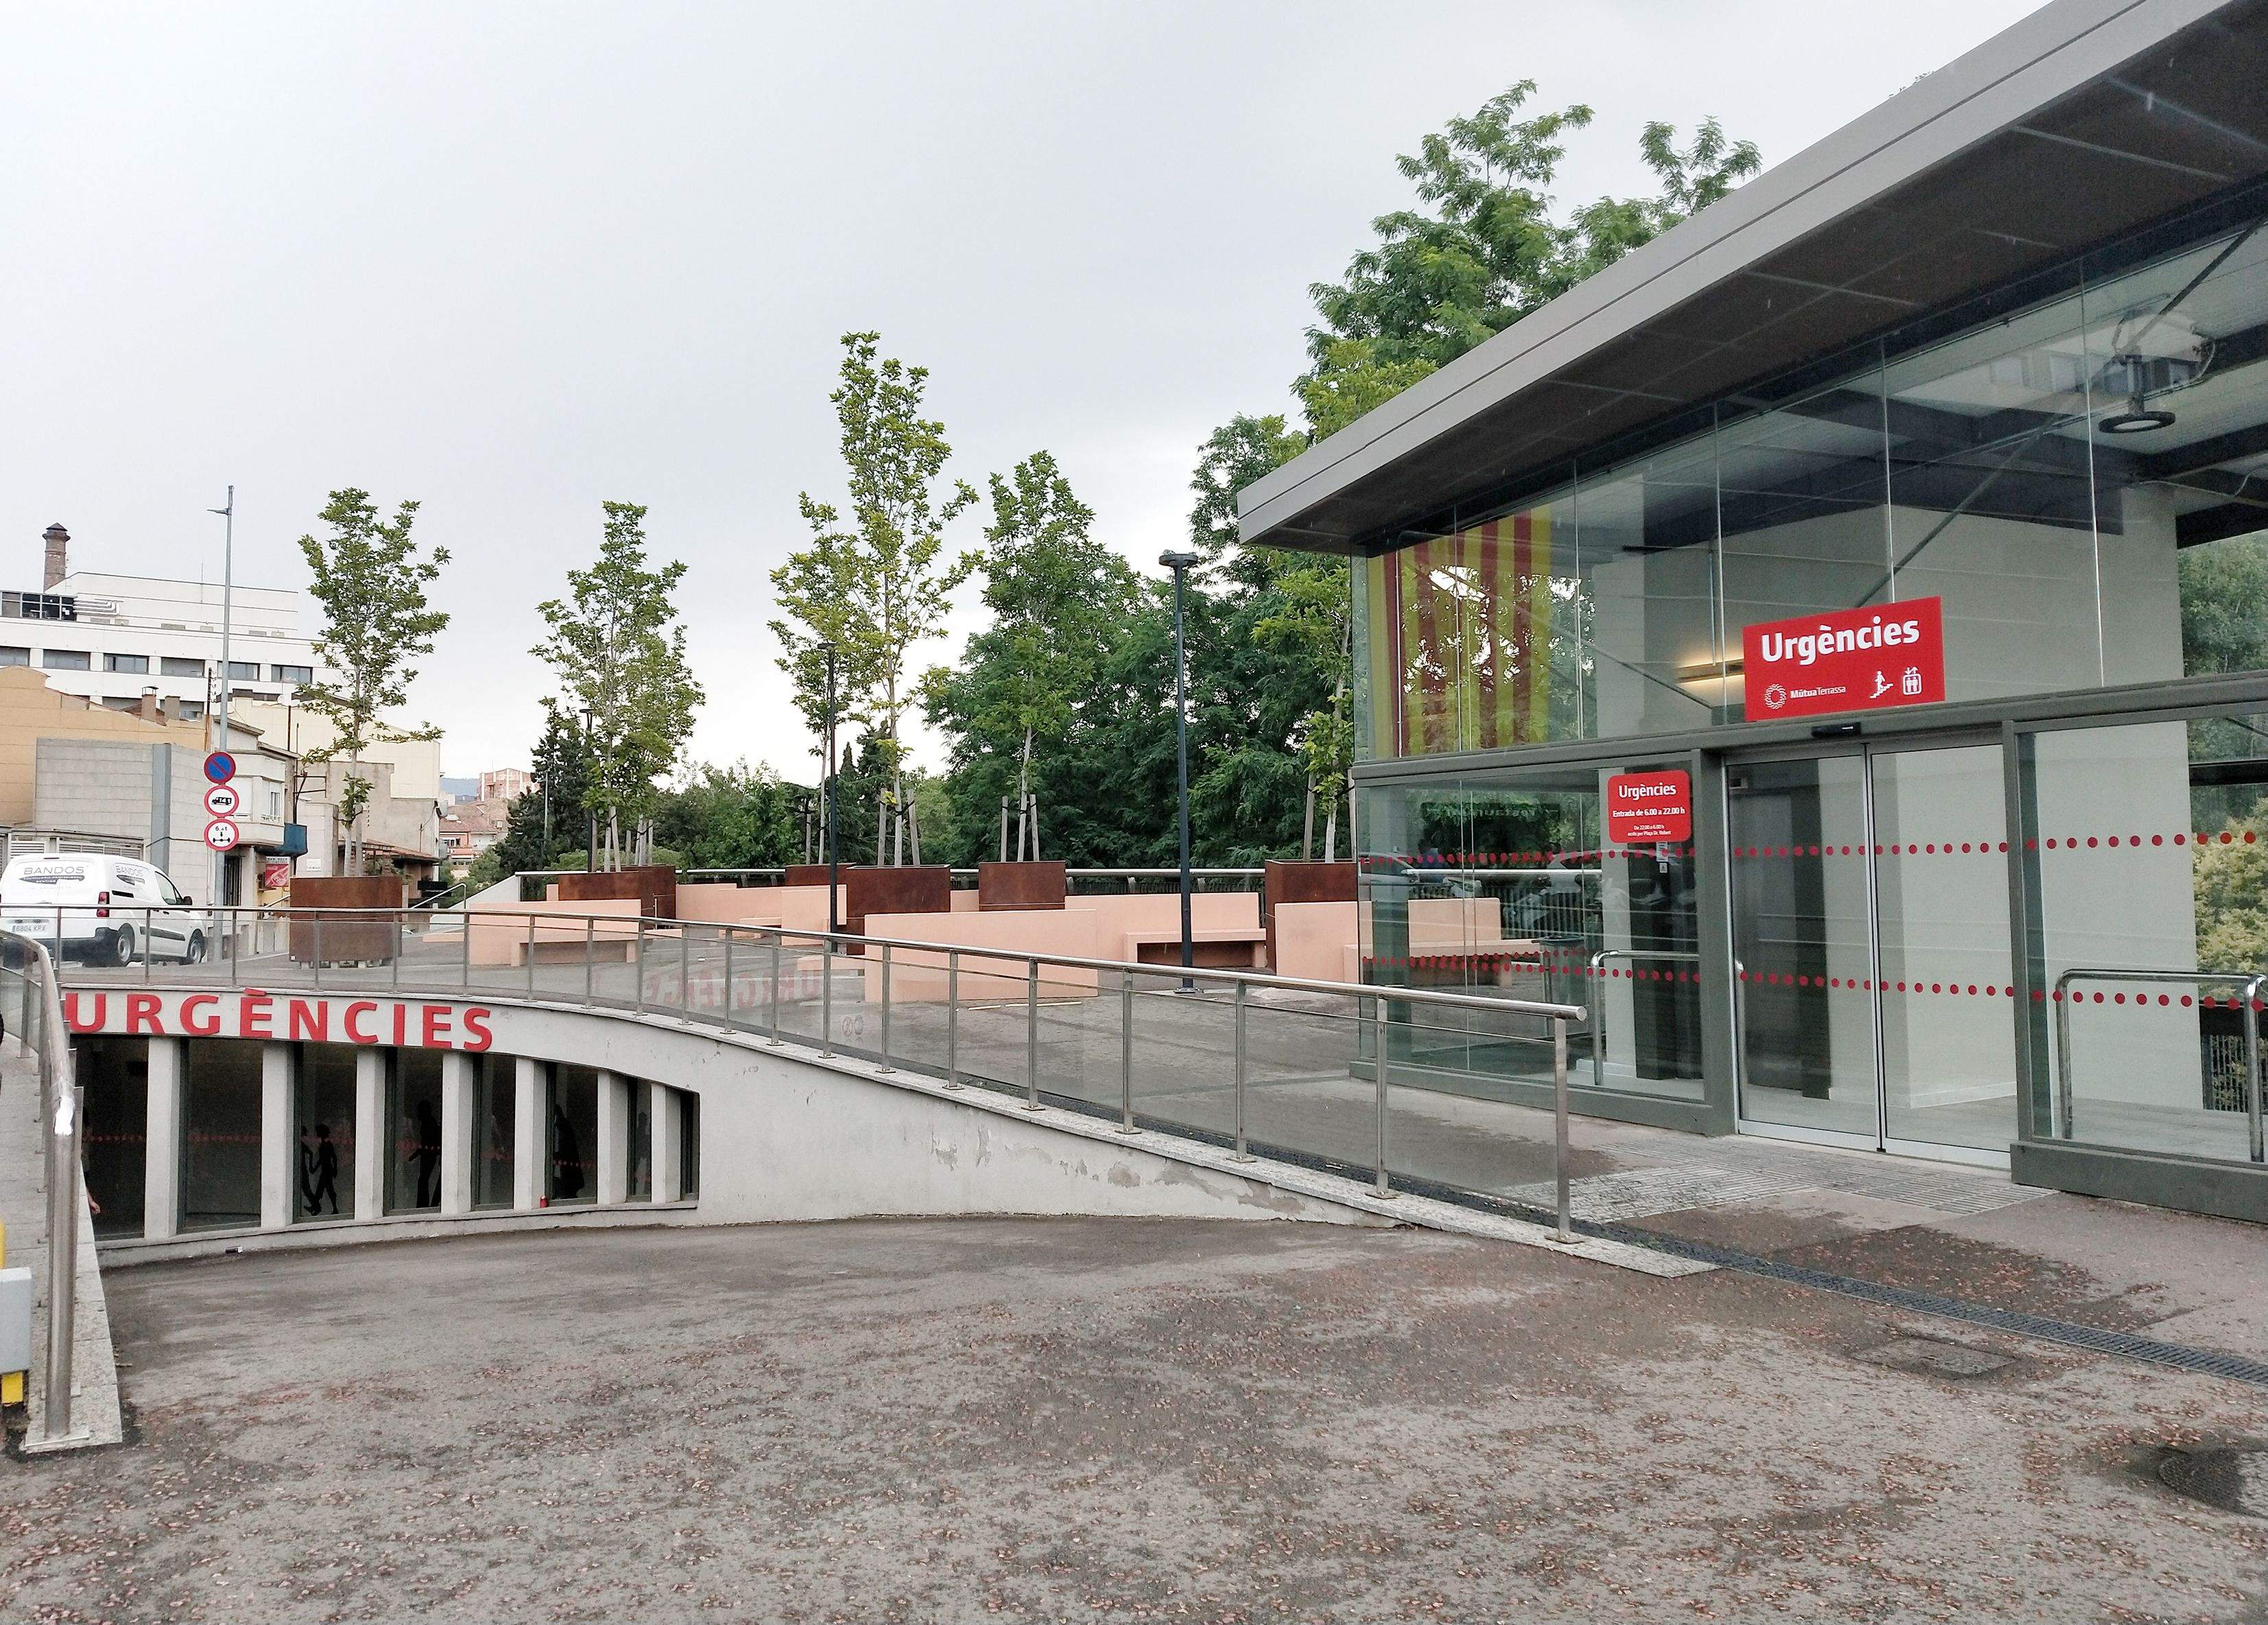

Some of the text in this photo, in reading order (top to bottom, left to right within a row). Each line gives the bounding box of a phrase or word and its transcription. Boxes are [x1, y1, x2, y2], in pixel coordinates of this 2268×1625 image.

[1761, 615, 1920, 665] Urgències
[1619, 783, 1677, 800] Urgències
[1612, 809, 1635, 818] Entrada
[1636, 808, 1644, 816] de
[1644, 808, 1658, 816] 6.00
[1680, 806, 1686, 814] h
[23, 866, 84, 875] BANDOS
[64, 988, 493, 1052] URGÈNCIES
